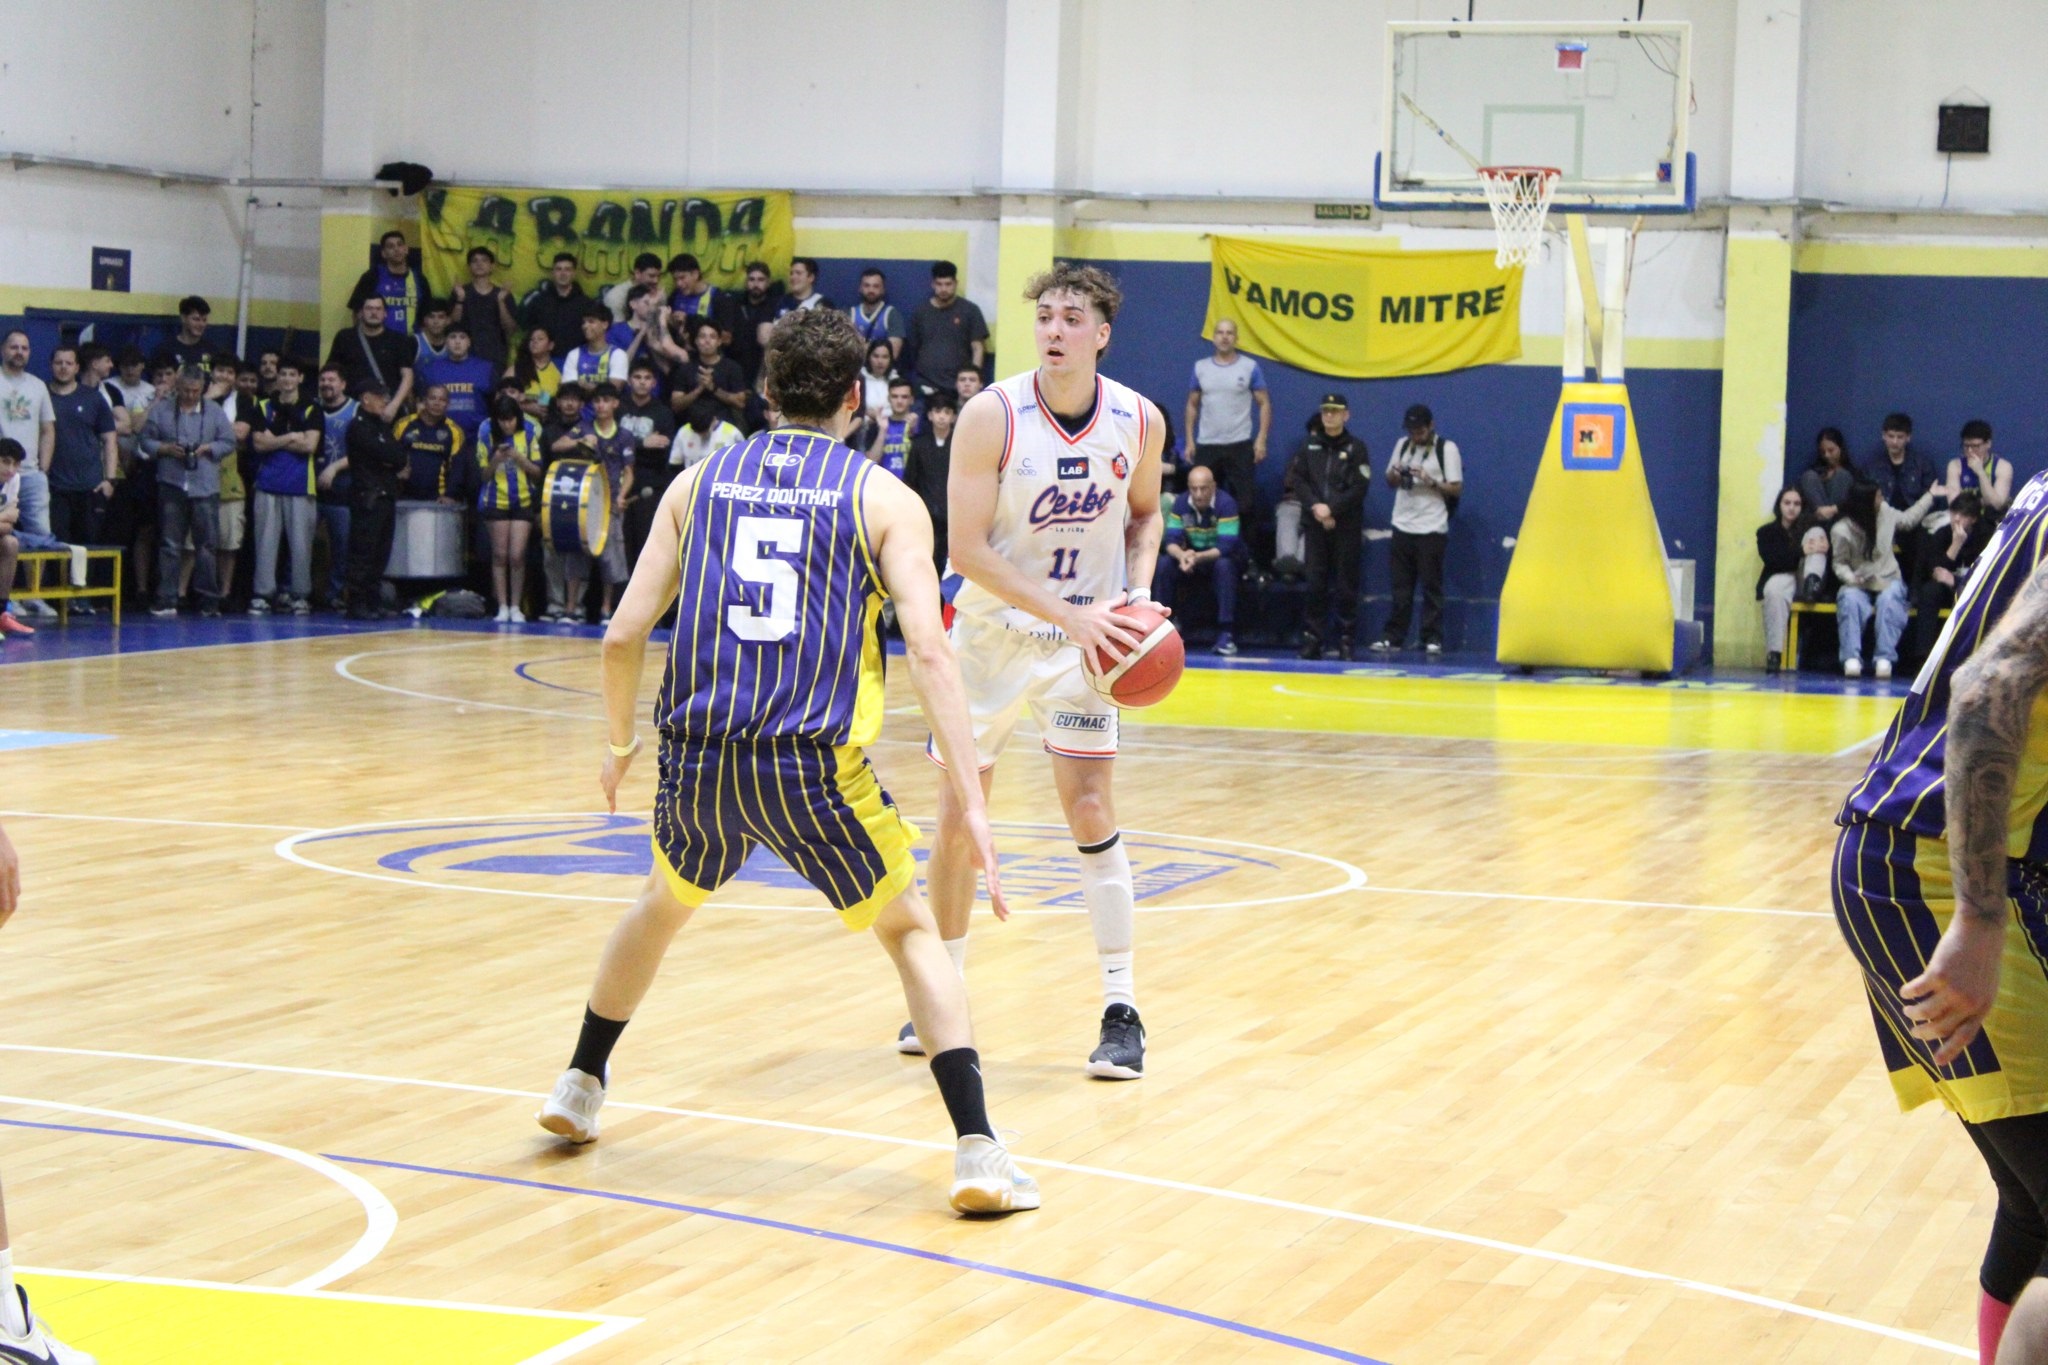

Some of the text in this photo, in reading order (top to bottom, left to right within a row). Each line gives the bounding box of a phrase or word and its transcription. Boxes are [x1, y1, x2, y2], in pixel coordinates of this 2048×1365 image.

[528, 196, 768, 275] BANDA
[1224, 266, 1506, 323] VAMOS MITRE
[1060, 466, 1084, 475] LAB
[710, 482, 843, 507] PEREZ DOUTHAT
[1029, 482, 1116, 524] Ceibo
[727, 516, 804, 641] 5
[1047, 548, 1080, 580] 11
[1063, 594, 1095, 606] ORTE
[1056, 714, 1107, 729] CUTMAC
